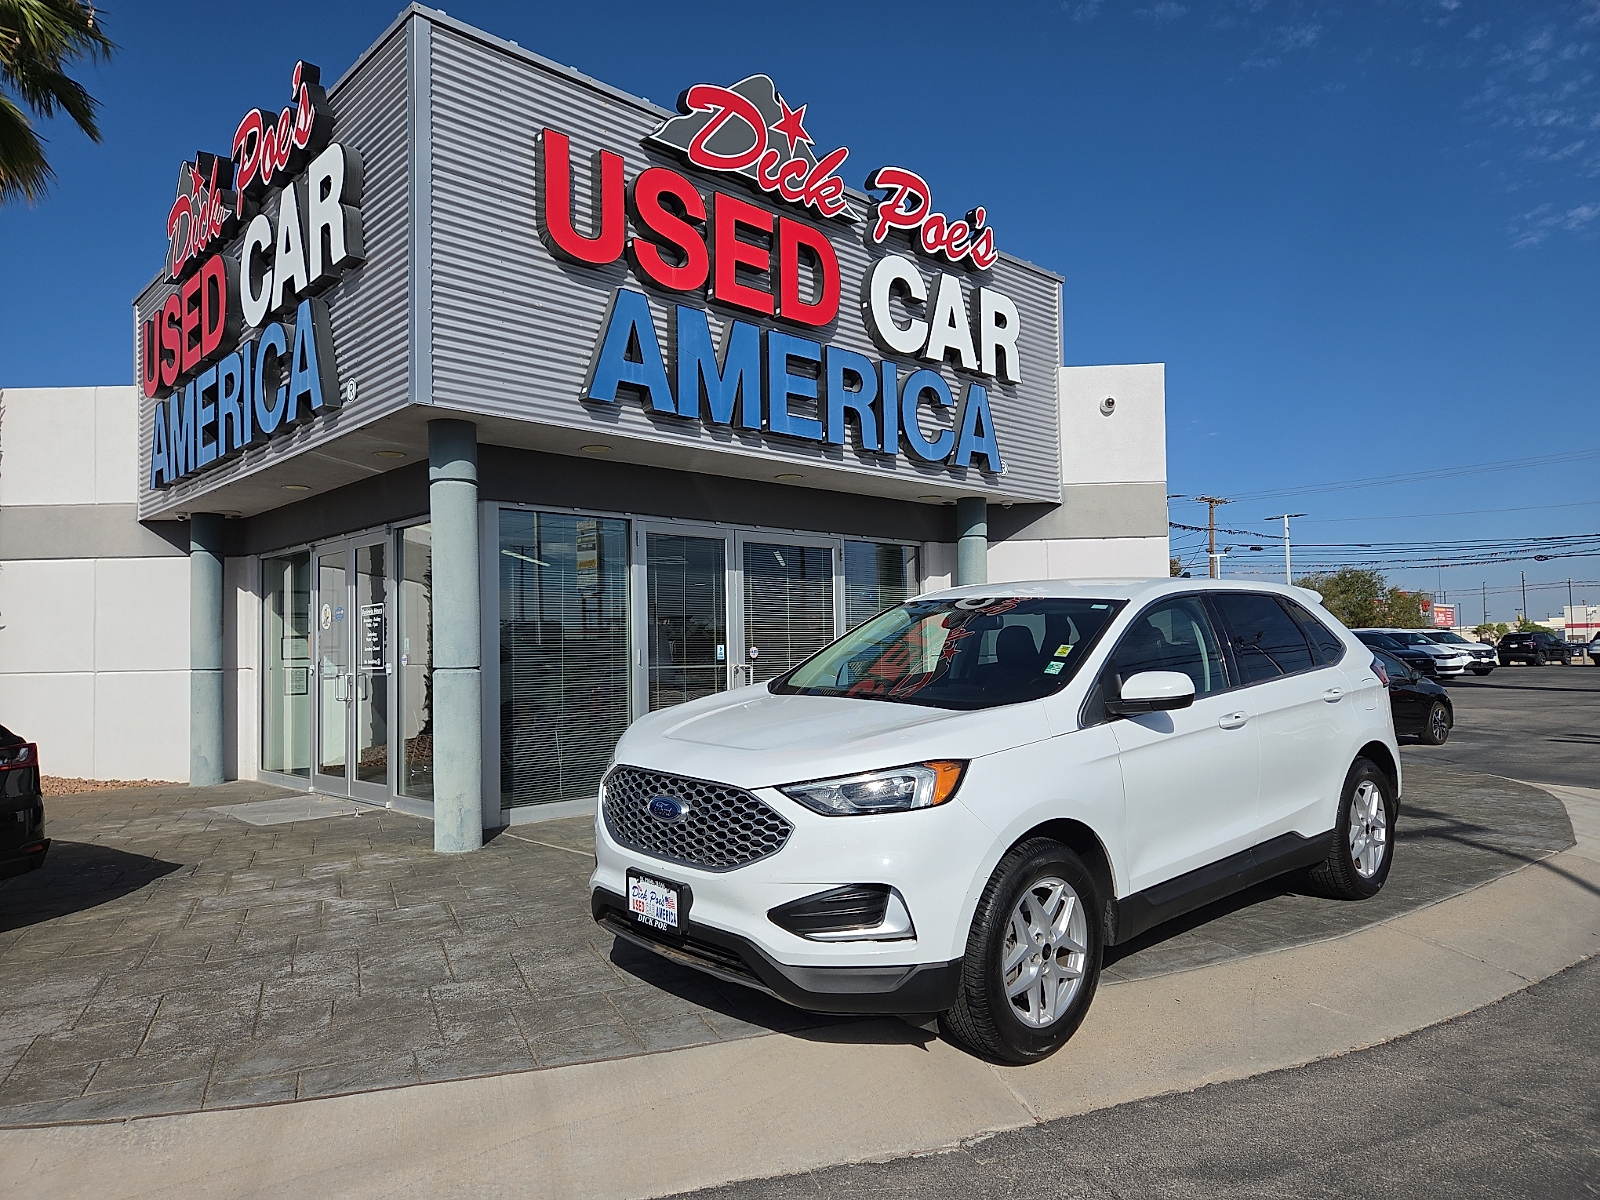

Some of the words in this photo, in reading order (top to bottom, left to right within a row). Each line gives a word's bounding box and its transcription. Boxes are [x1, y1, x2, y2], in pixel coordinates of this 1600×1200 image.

[167, 155, 223, 280] Dick
[232, 59, 317, 219] Poe's
[543, 128, 841, 326] USED
[869, 254, 1021, 384] CAR
[686, 84, 850, 217] Dick
[872, 166, 999, 271] Poe's
[143, 254, 227, 399] USED
[240, 142, 348, 328] CAR
[150, 298, 324, 490] AMERICA
[589, 288, 1002, 474] AMERICA
[637, 913, 654, 926] DICK
[654, 919, 668, 931] POE
